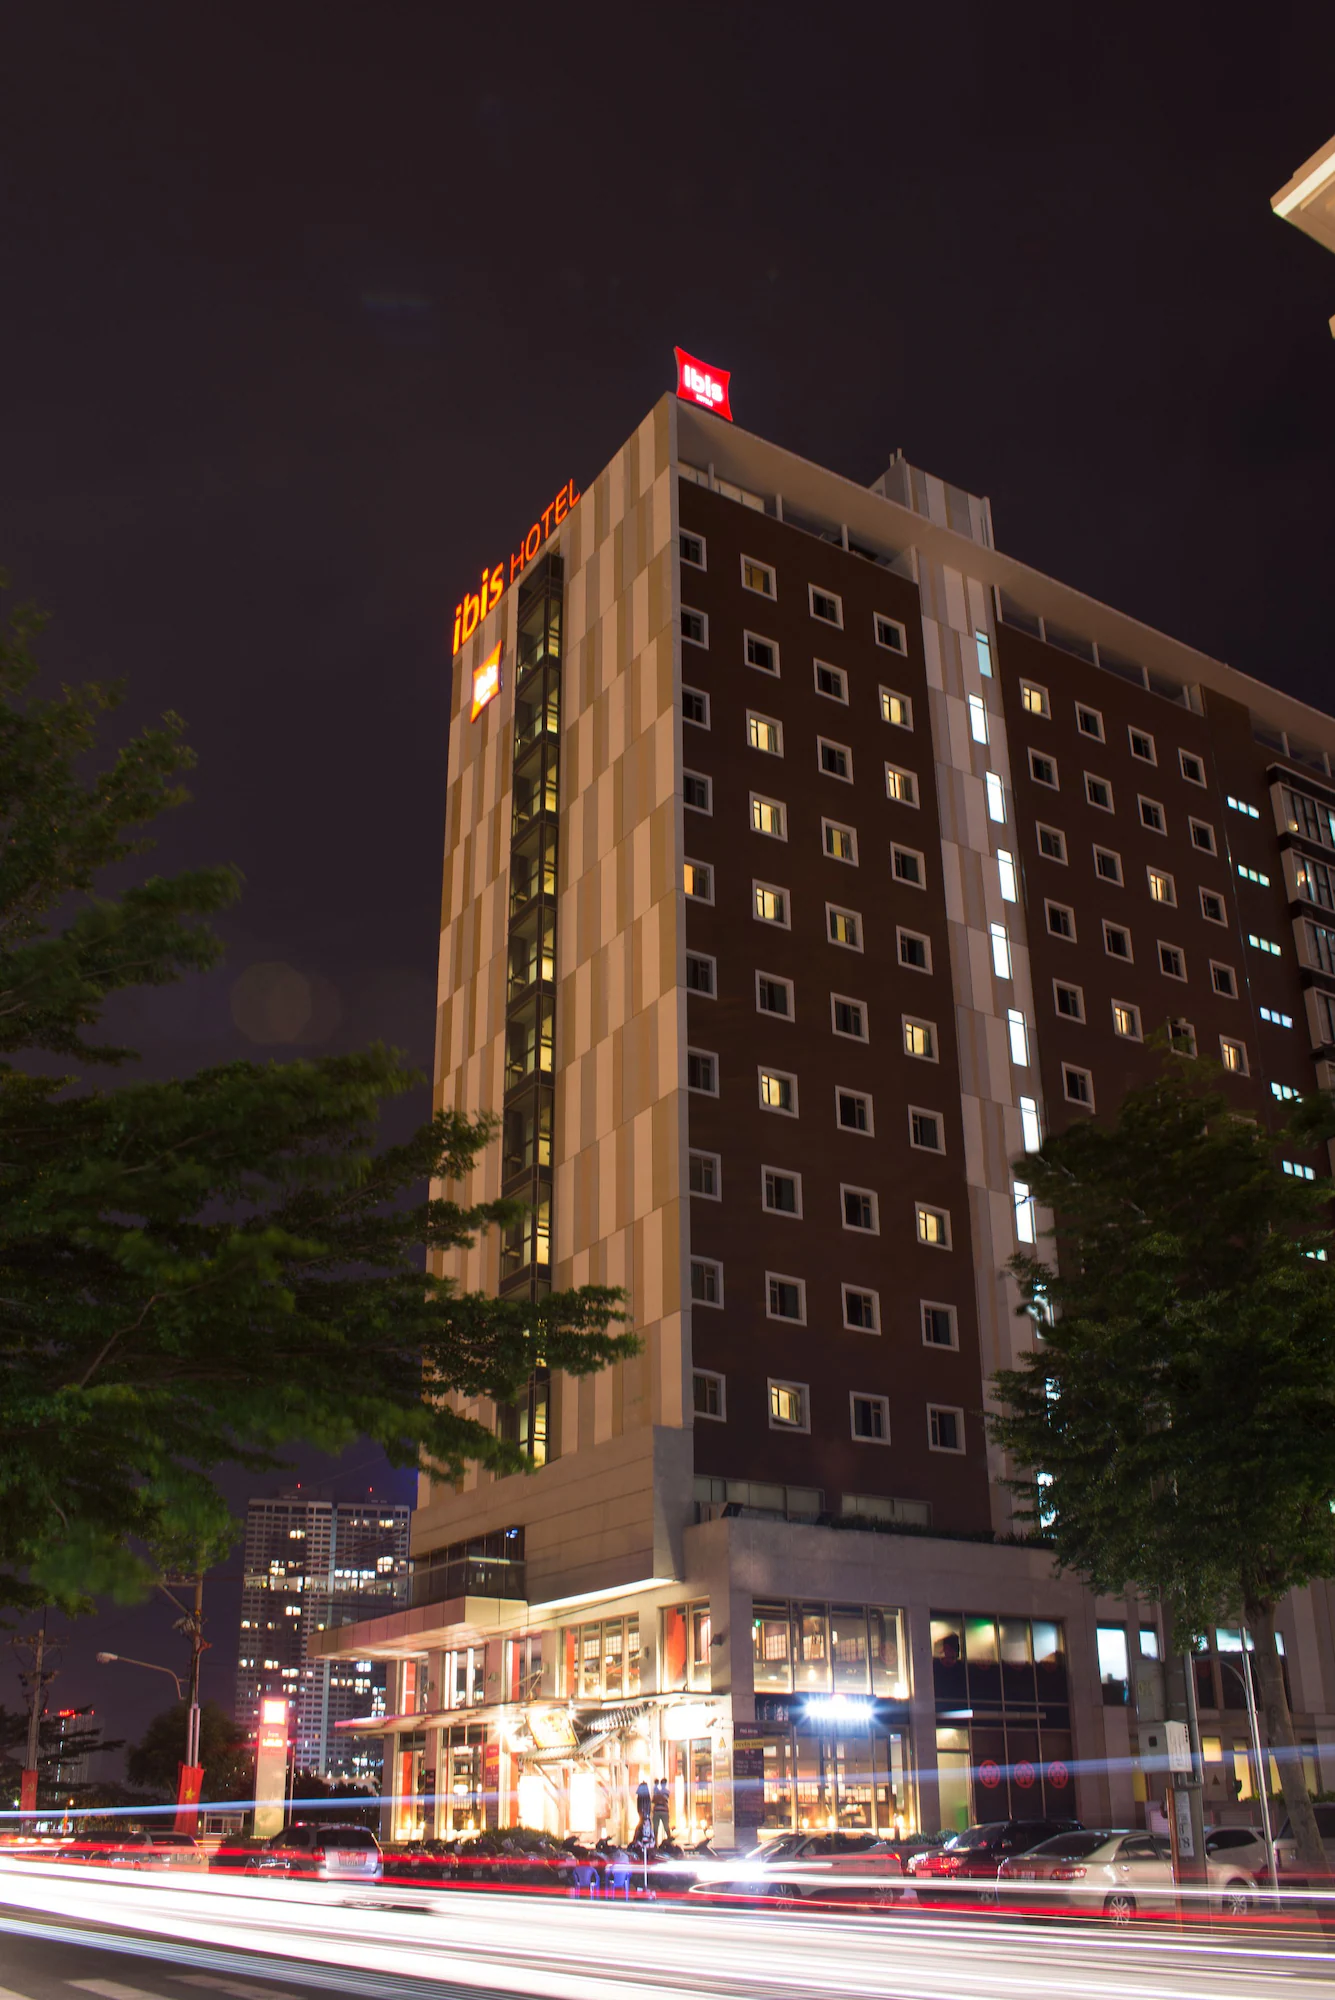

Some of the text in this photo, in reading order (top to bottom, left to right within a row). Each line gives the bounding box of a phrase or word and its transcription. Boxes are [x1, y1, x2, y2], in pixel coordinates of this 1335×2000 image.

[684, 364, 723, 402] ibis
[452, 478, 581, 656] ibis HOTEL
